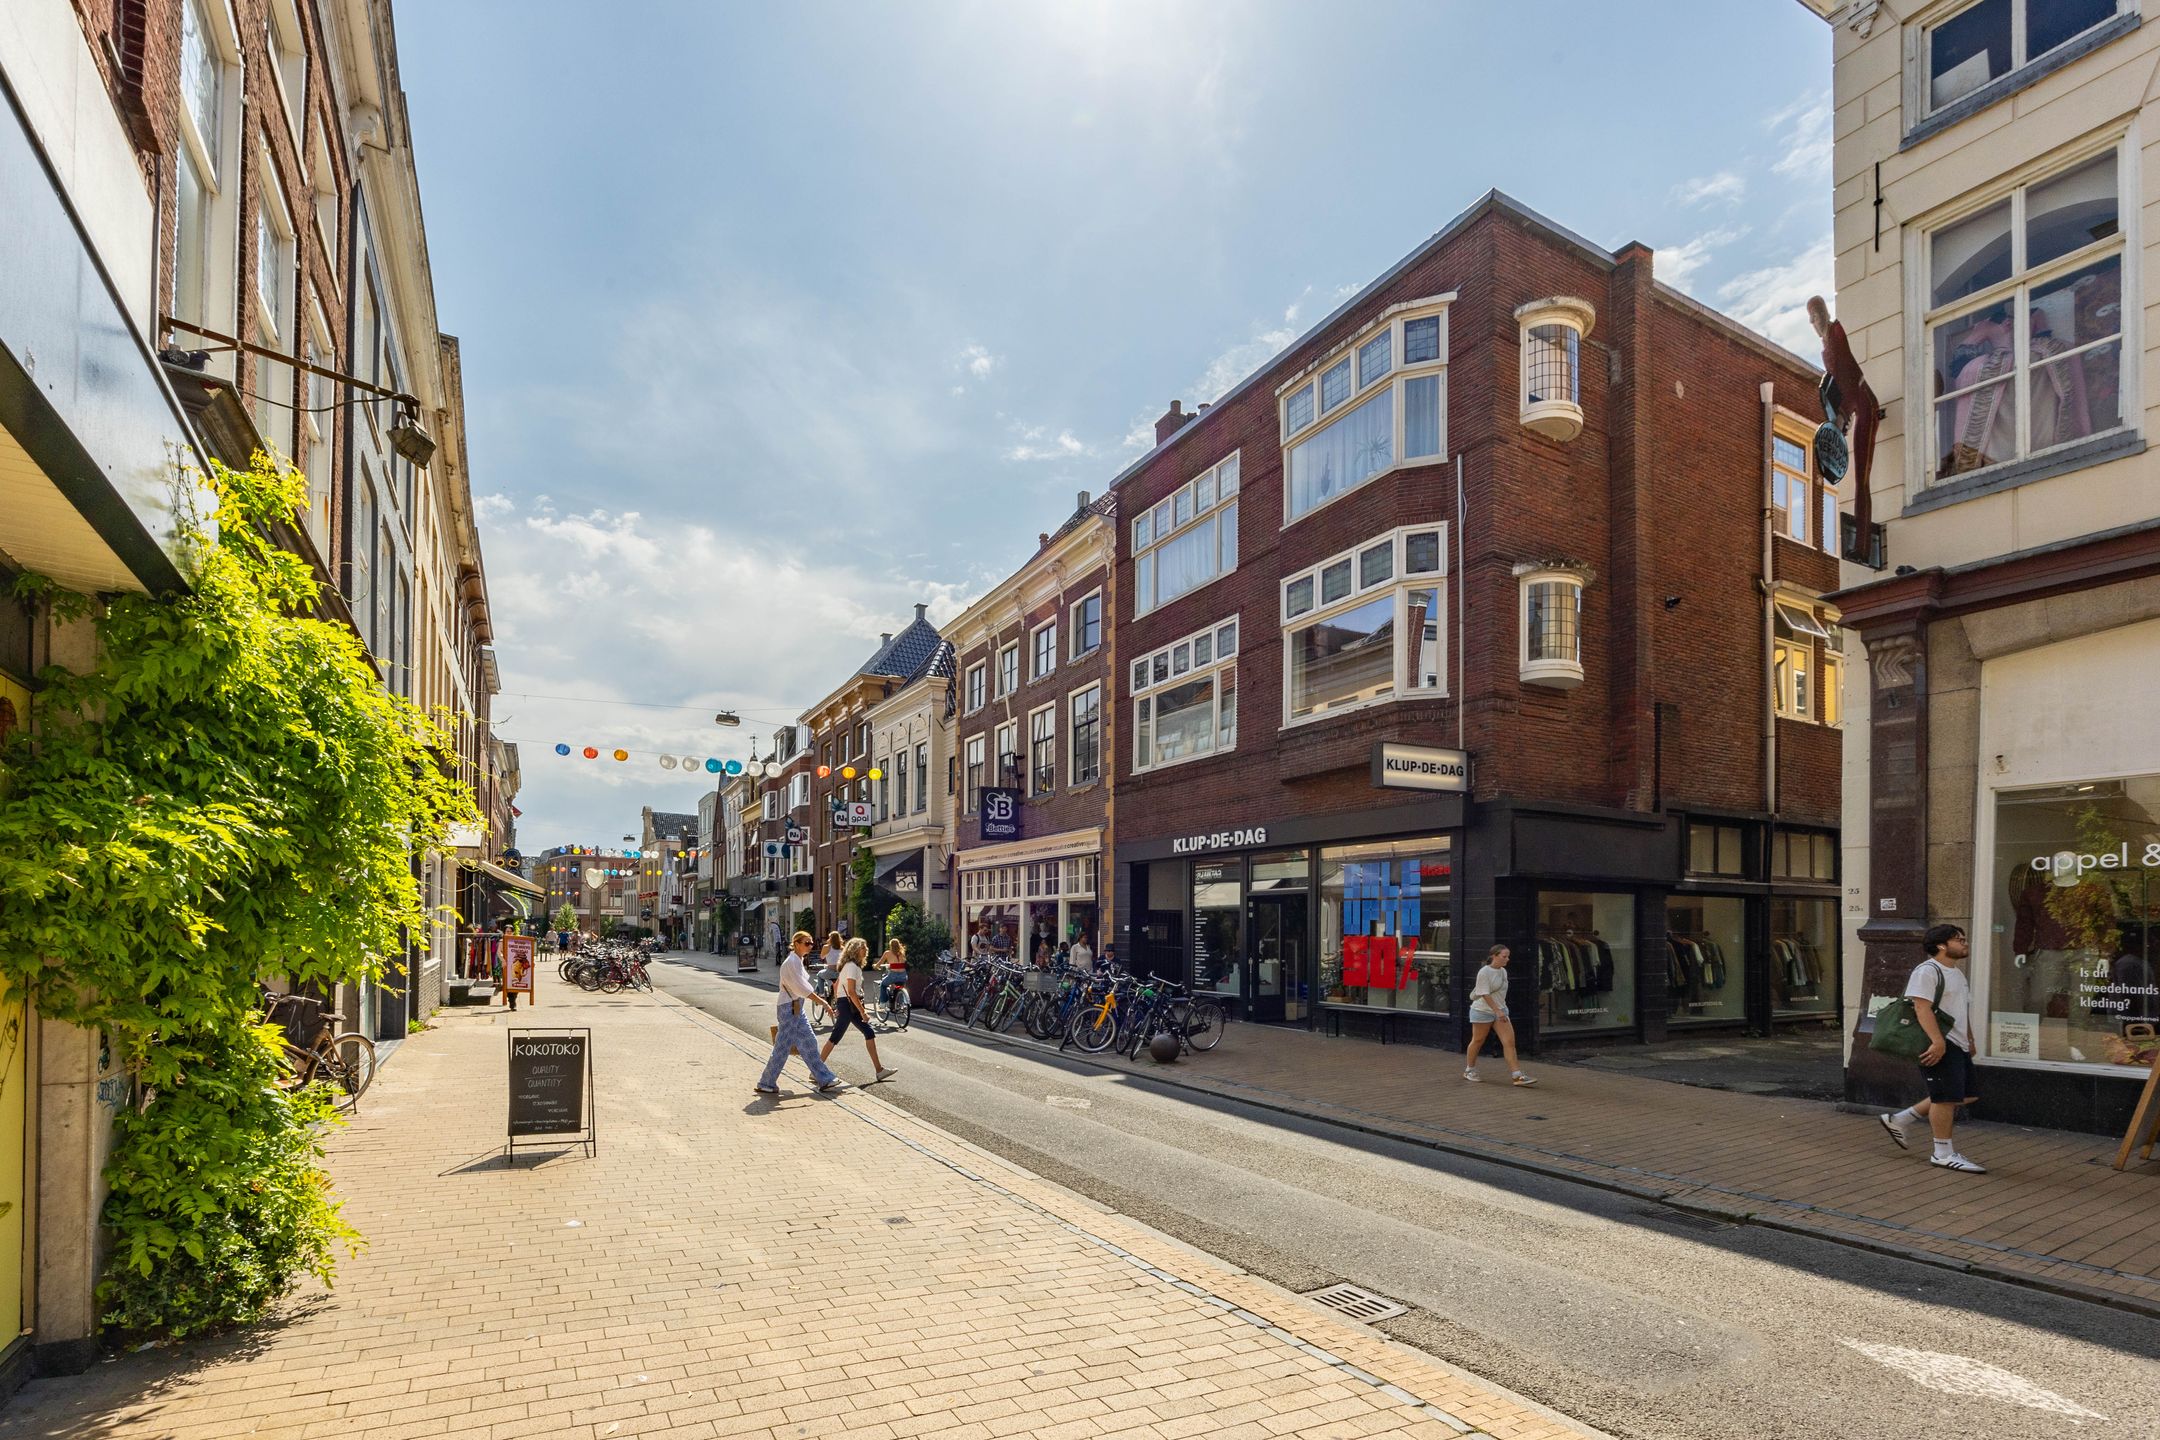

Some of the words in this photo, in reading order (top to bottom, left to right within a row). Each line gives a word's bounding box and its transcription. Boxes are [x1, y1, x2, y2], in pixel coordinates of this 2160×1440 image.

[851, 815, 870, 824] gpal
[2031, 842, 2127, 877] appel
[2142, 843, 2160, 867] &
[1848, 887, 1860, 895] 25
[1343, 935, 1418, 990] 50%
[2080, 967, 2089, 978] Is
[2080, 982, 2159, 995] tweedehands
[2080, 996, 2130, 1011] kleding?
[515, 1043, 581, 1057] KOKOTOKO
[532, 1064, 560, 1075] QUALITY
[527, 1079, 562, 1089] QUANTITY
